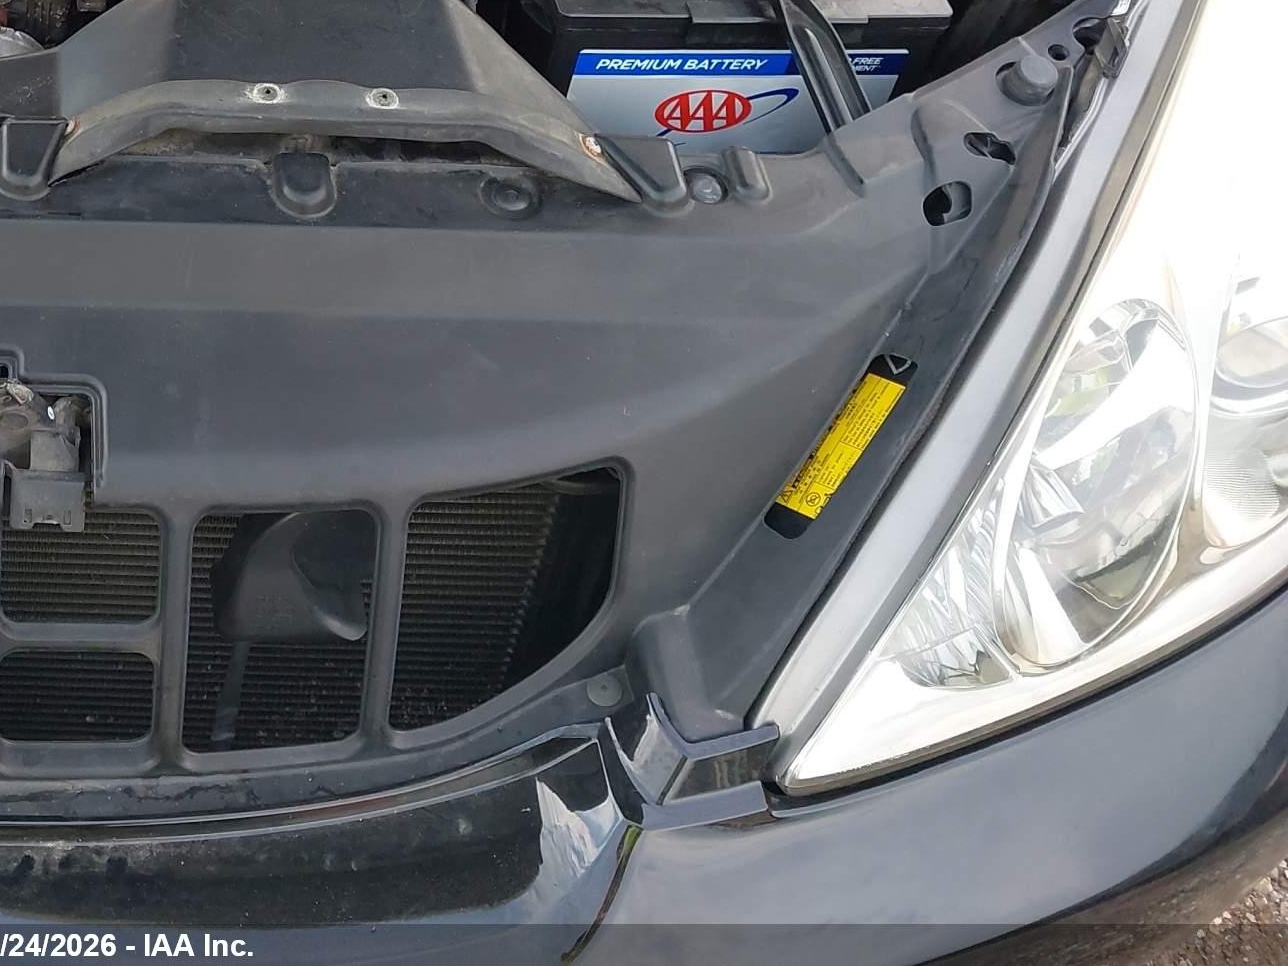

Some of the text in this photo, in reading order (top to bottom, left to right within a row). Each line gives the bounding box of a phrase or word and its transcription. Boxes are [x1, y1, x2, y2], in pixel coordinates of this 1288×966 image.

[595, 58, 769, 71] PREMIUM BATTERY
[663, 90, 741, 131] AAA
